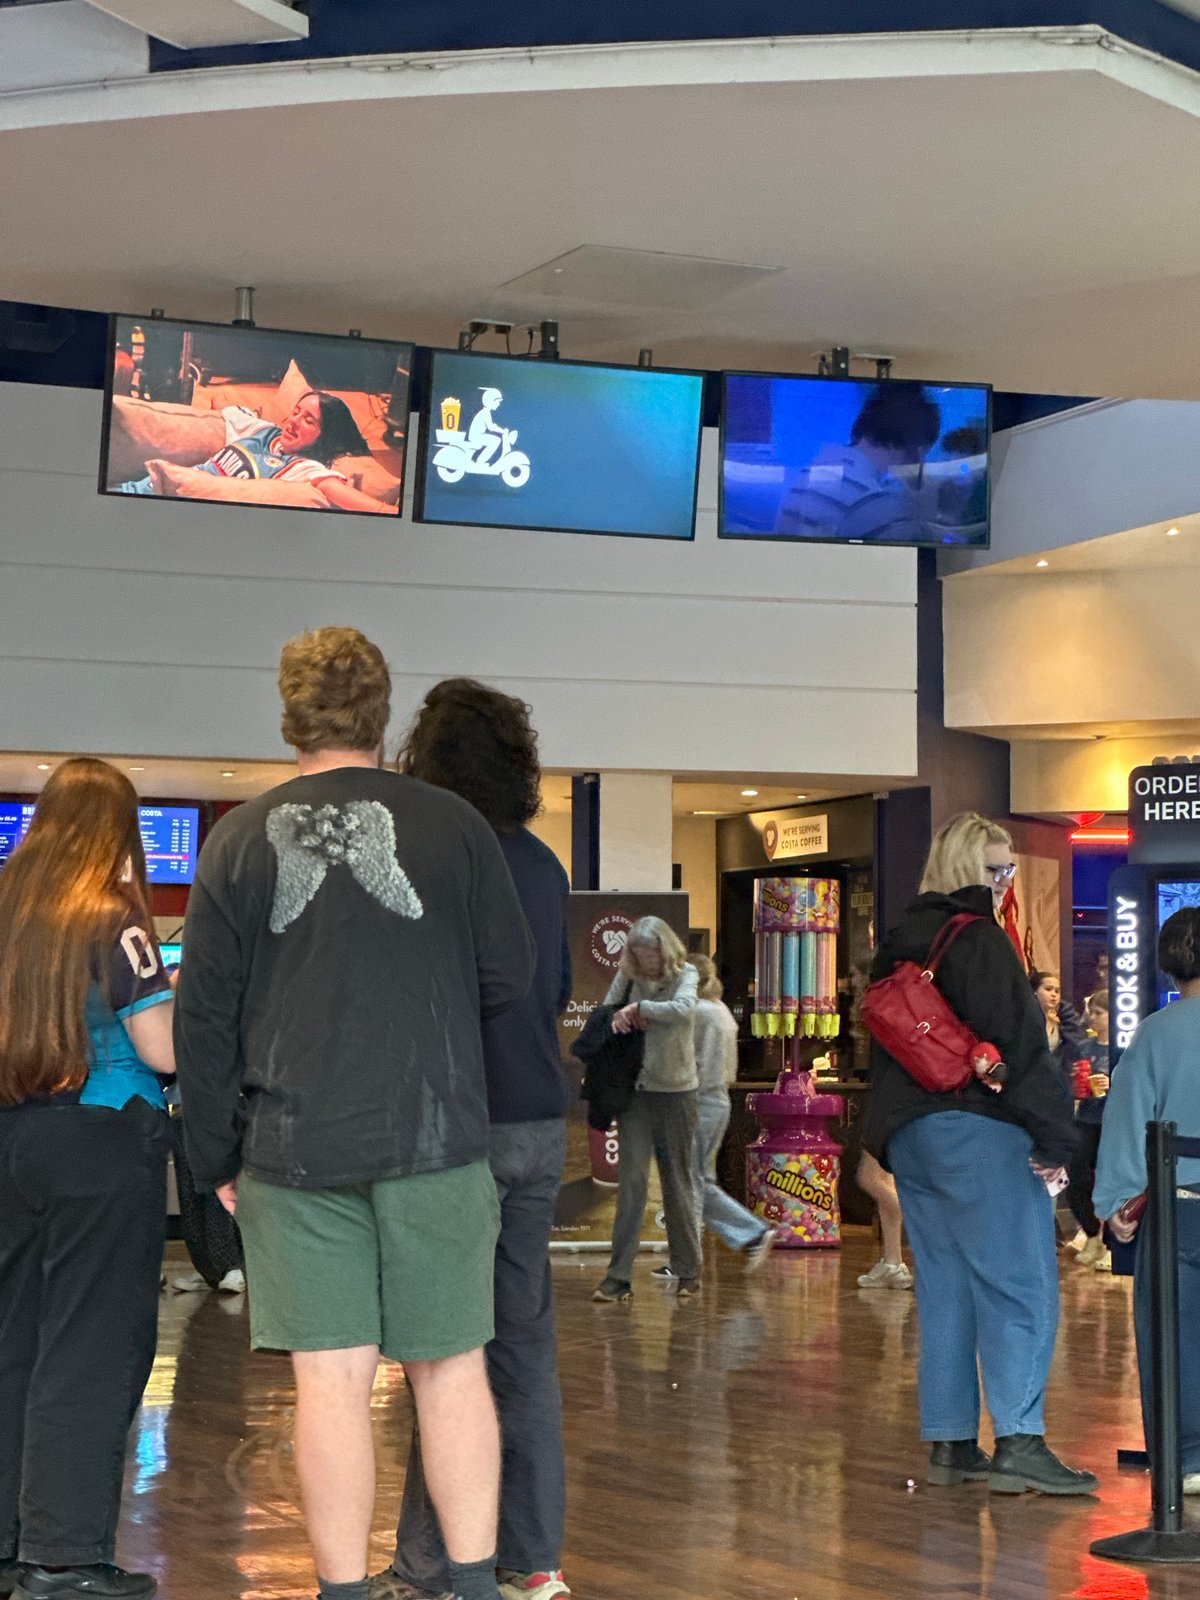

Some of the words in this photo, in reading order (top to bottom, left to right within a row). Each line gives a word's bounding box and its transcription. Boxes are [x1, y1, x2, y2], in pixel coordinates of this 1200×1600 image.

[1135, 775, 1200, 795] ORDE
[1145, 801, 1200, 821] HERE
[799, 823, 820, 835] SERVING
[781, 839, 799, 850] COSTA
[800, 835, 822, 847] COFFEE
[1116, 896, 1137, 949] BUY
[563, 1015, 587, 1032] only
[765, 1168, 833, 1211] millions
